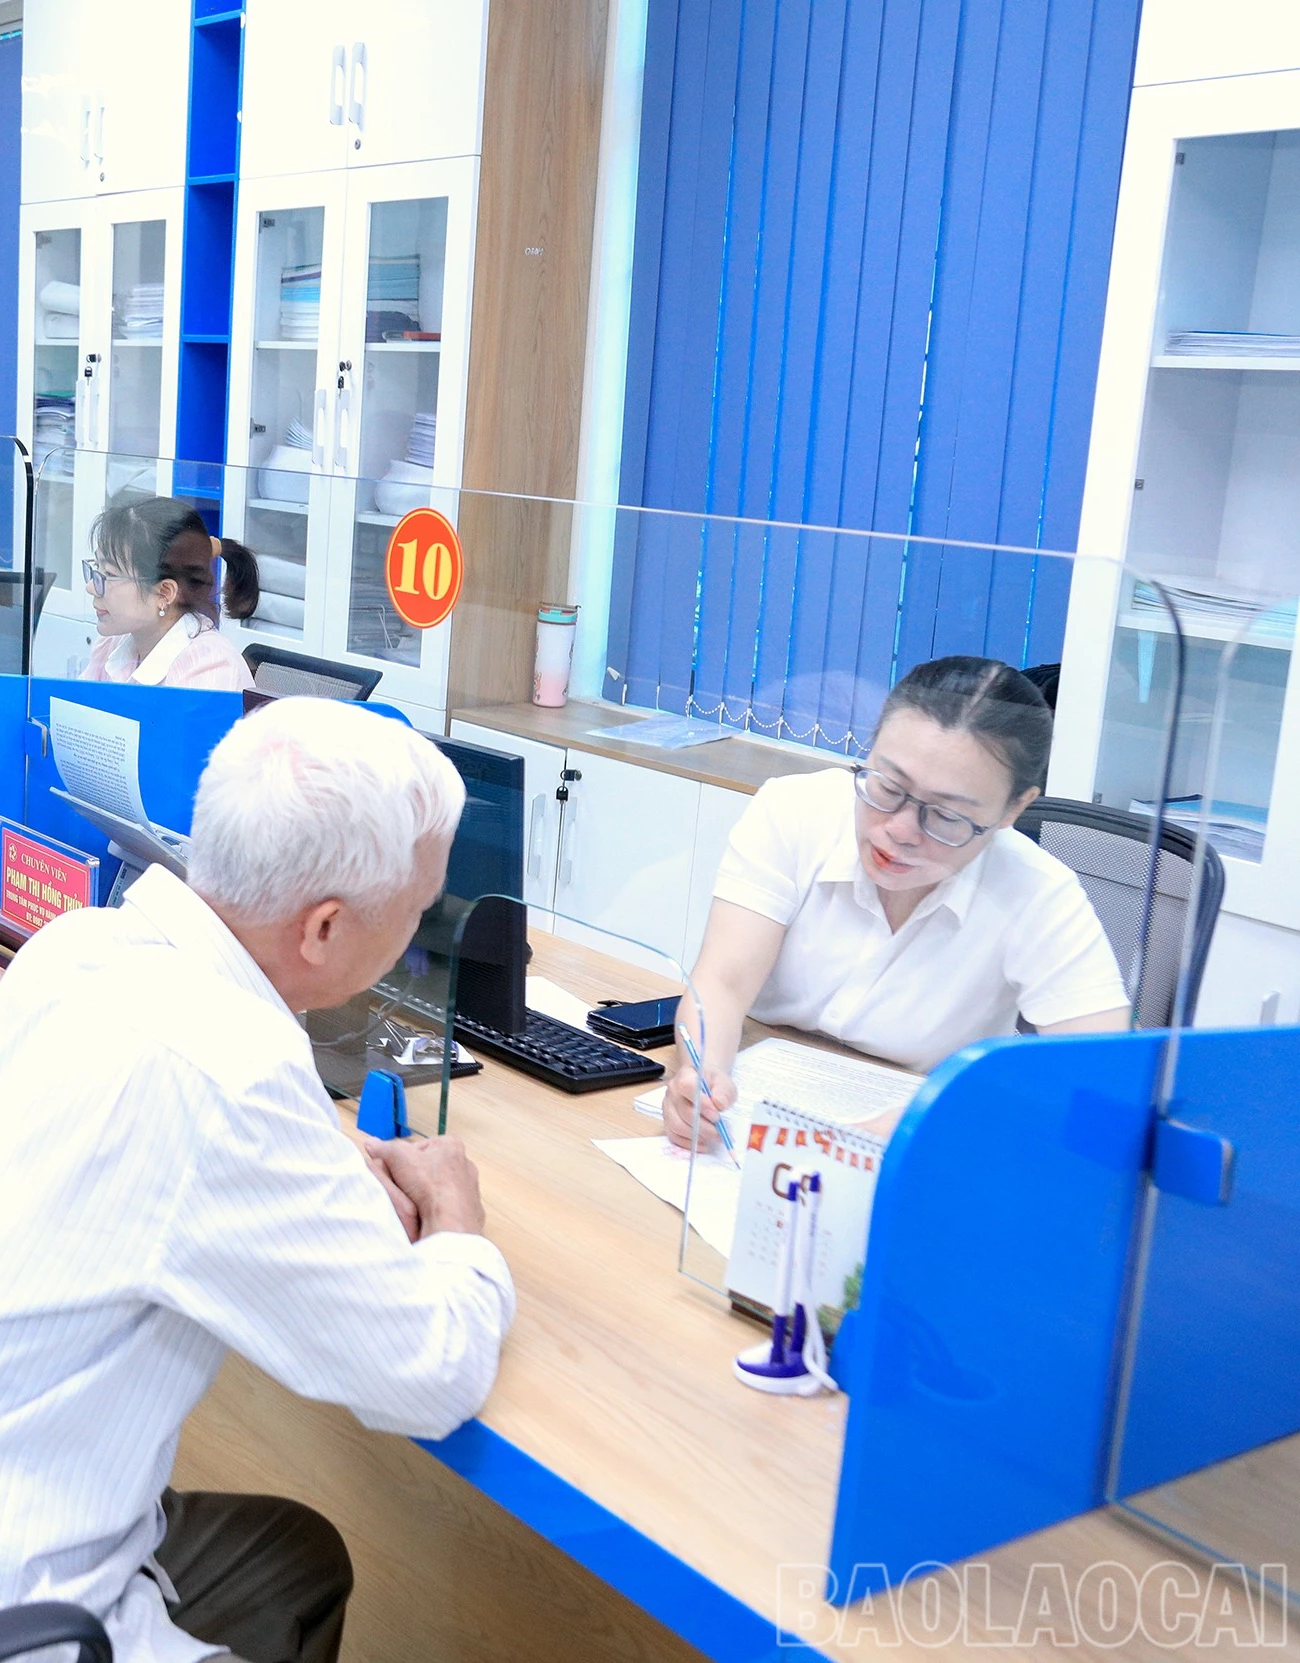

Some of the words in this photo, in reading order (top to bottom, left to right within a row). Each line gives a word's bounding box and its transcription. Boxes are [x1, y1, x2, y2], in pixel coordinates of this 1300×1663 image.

[394, 538, 452, 600] 10
[6, 866, 26, 891] PHẠM
[29, 877, 41, 902] THỊ
[41, 881, 62, 909] HỒNG
[21, 853, 50, 874] CHUYÊN
[51, 866, 67, 883] VIÊN
